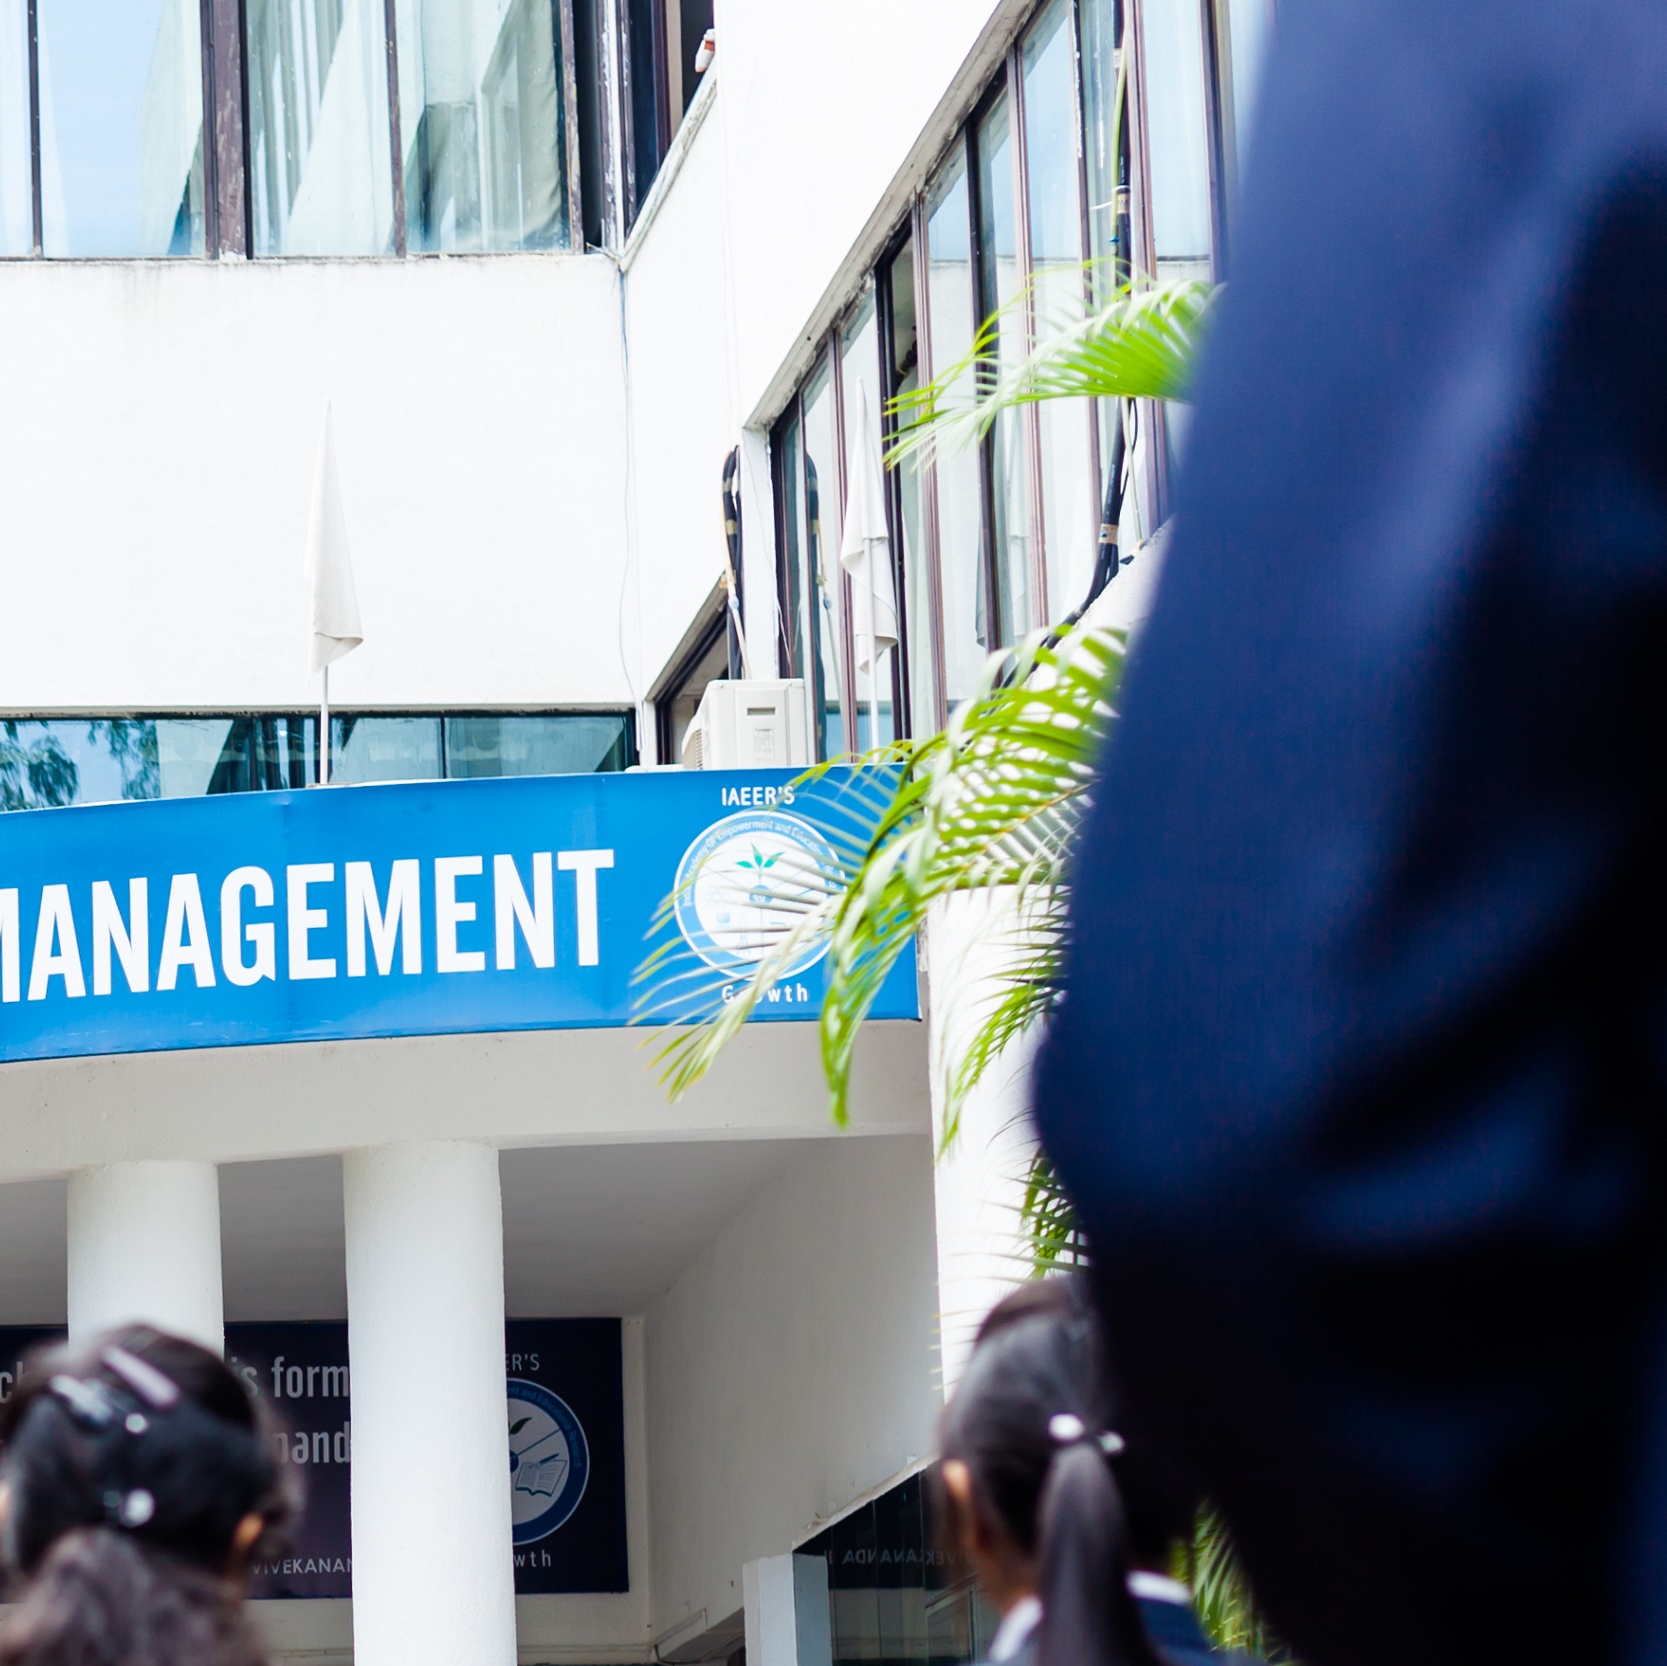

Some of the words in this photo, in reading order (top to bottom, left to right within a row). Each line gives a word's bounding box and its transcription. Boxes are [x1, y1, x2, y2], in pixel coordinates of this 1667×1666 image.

[721, 786, 795, 806] IAEER'S
[722, 983, 809, 1003] Gwth
[271, 1355, 349, 1399] form
